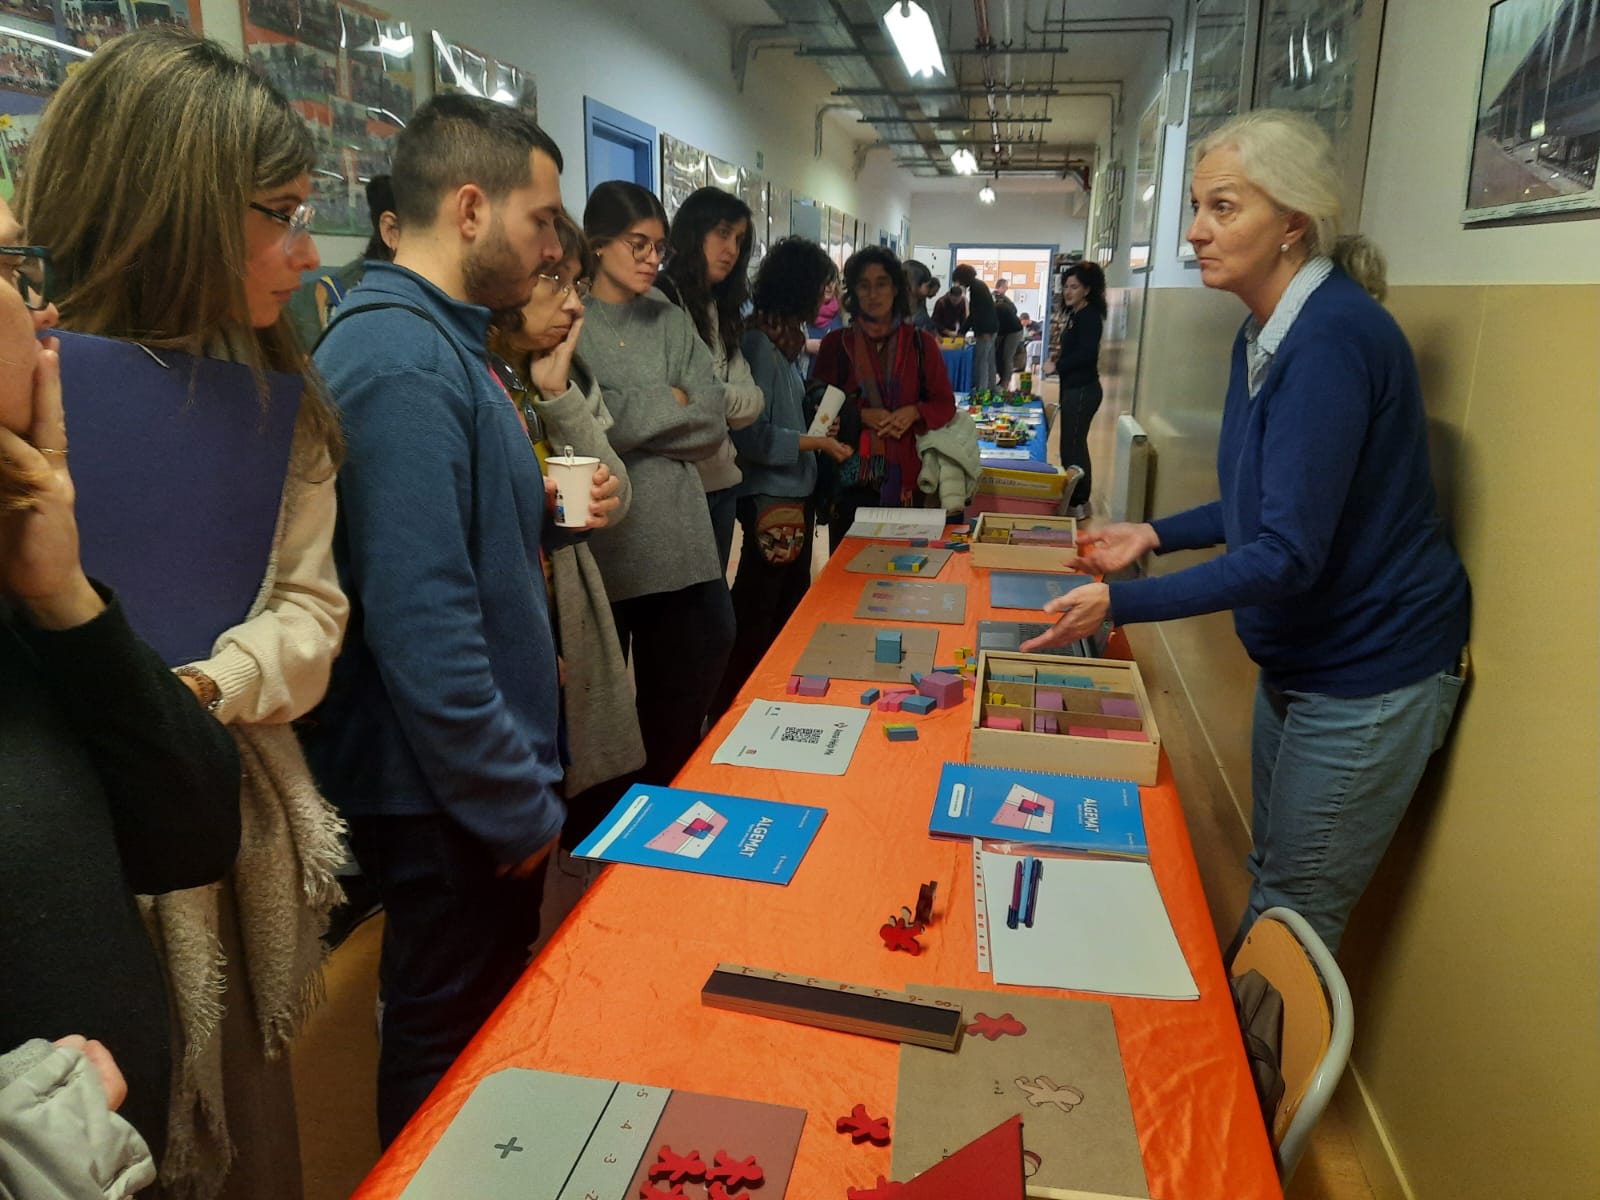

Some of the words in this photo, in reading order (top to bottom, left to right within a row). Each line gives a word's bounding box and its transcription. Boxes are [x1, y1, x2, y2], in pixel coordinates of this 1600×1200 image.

[1083, 797, 1099, 832] ALGEMAT
[739, 816, 774, 857] ALGEMAT
[637, 1088, 648, 1098] -5
[620, 1119, 632, 1130] -4
[603, 1153, 617, 1164] -3
